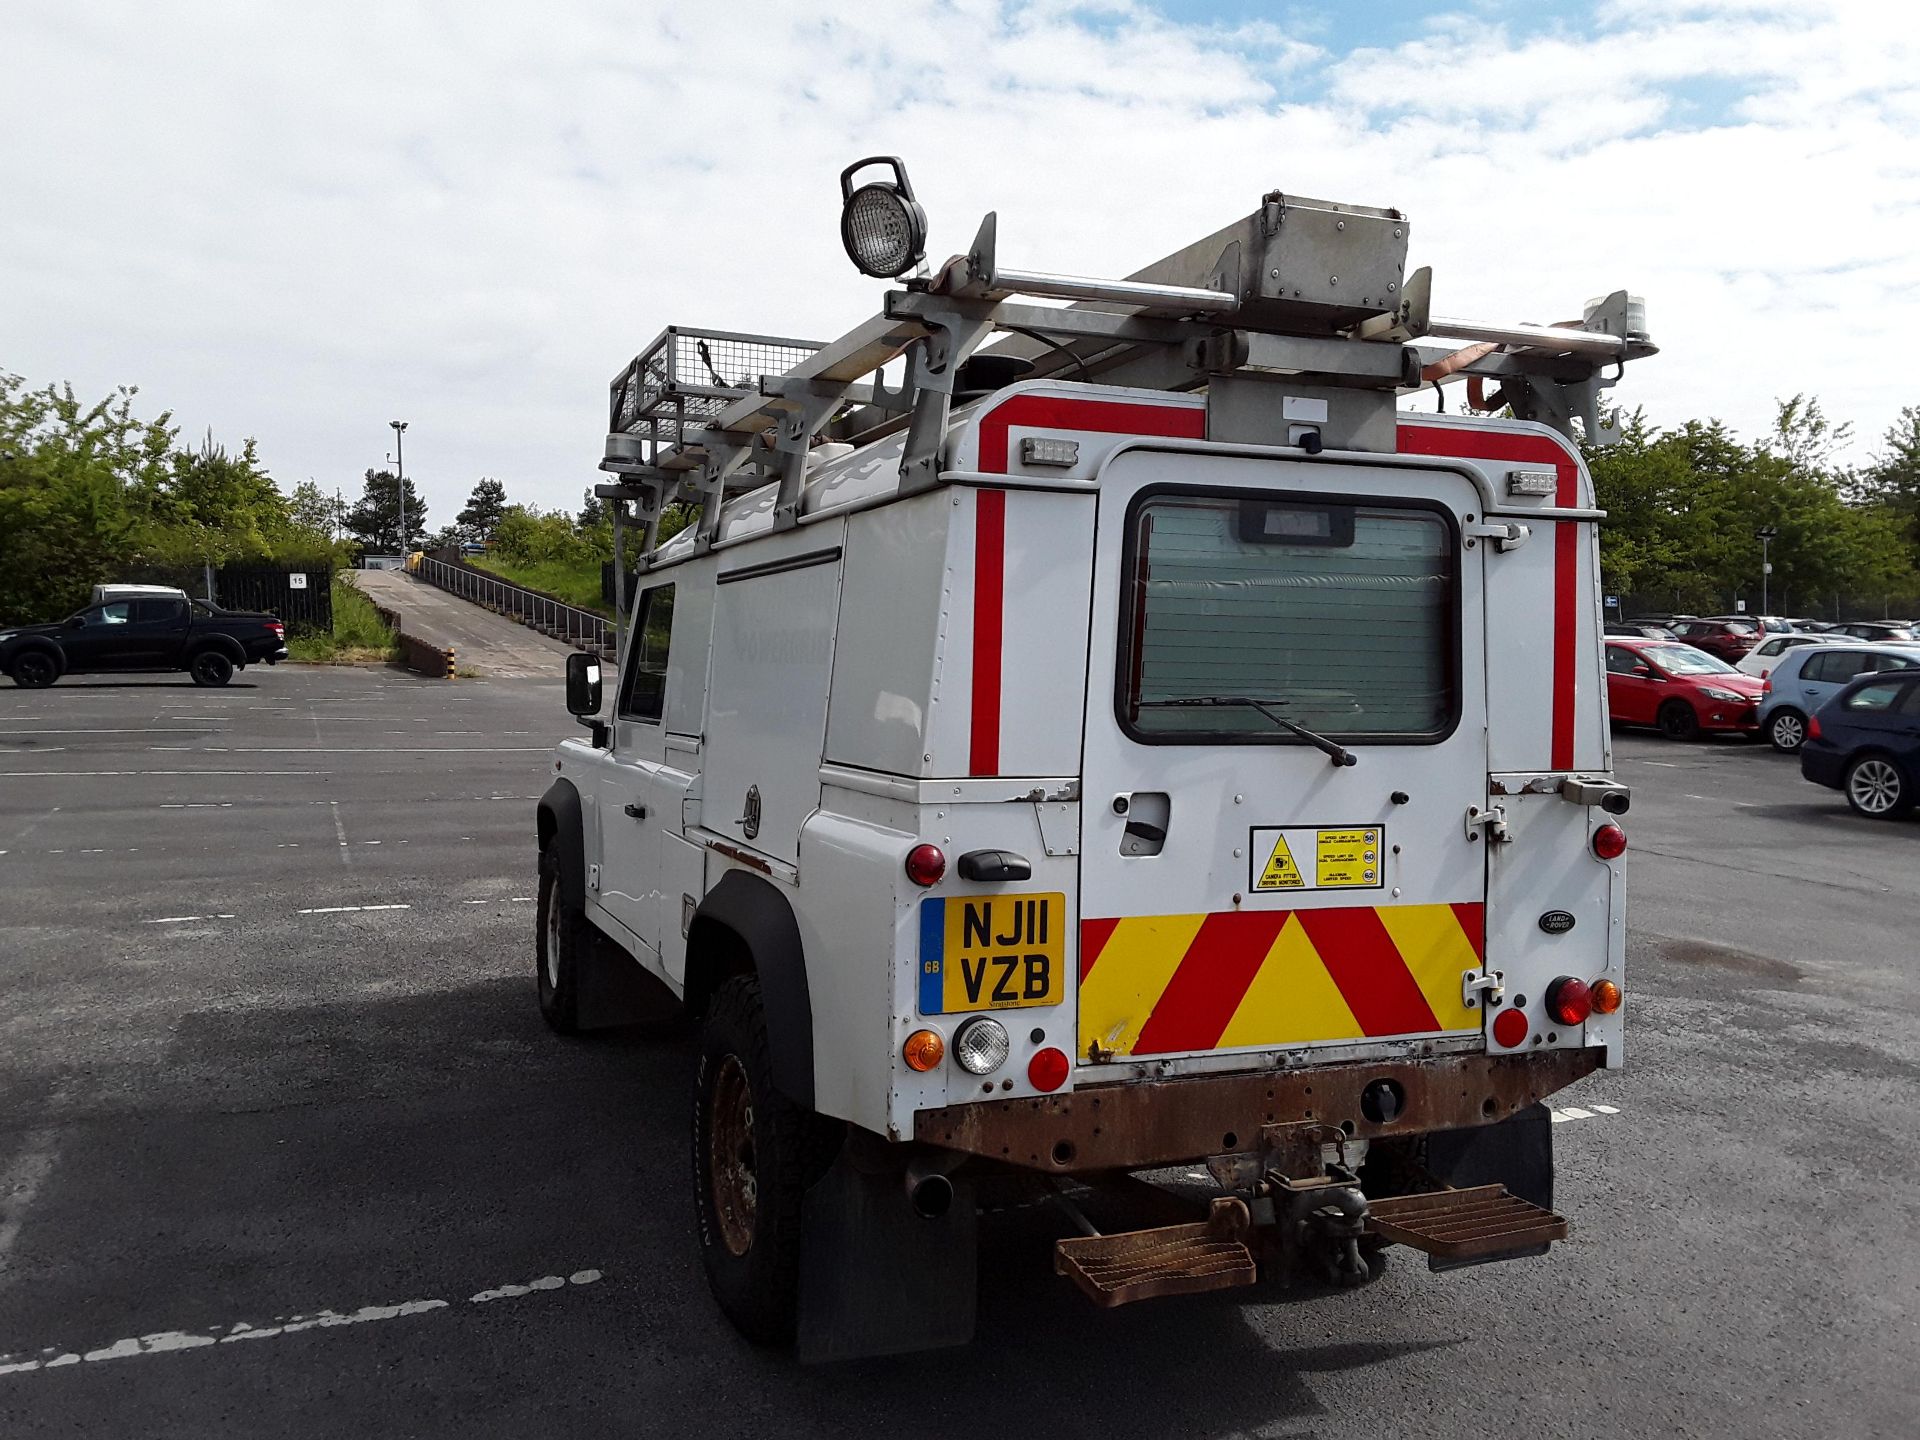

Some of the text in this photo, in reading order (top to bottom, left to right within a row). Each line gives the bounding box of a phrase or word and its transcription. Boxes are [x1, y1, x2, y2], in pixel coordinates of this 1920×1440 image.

[294, 577, 303, 585] 15
[1364, 834, 1375, 842] 50
[1364, 853, 1374, 861] 60
[1364, 872, 1374, 880] 62
[963, 900, 1048, 949] NJ11
[925, 961, 940, 974] GB
[960, 954, 1050, 1004] VZB
